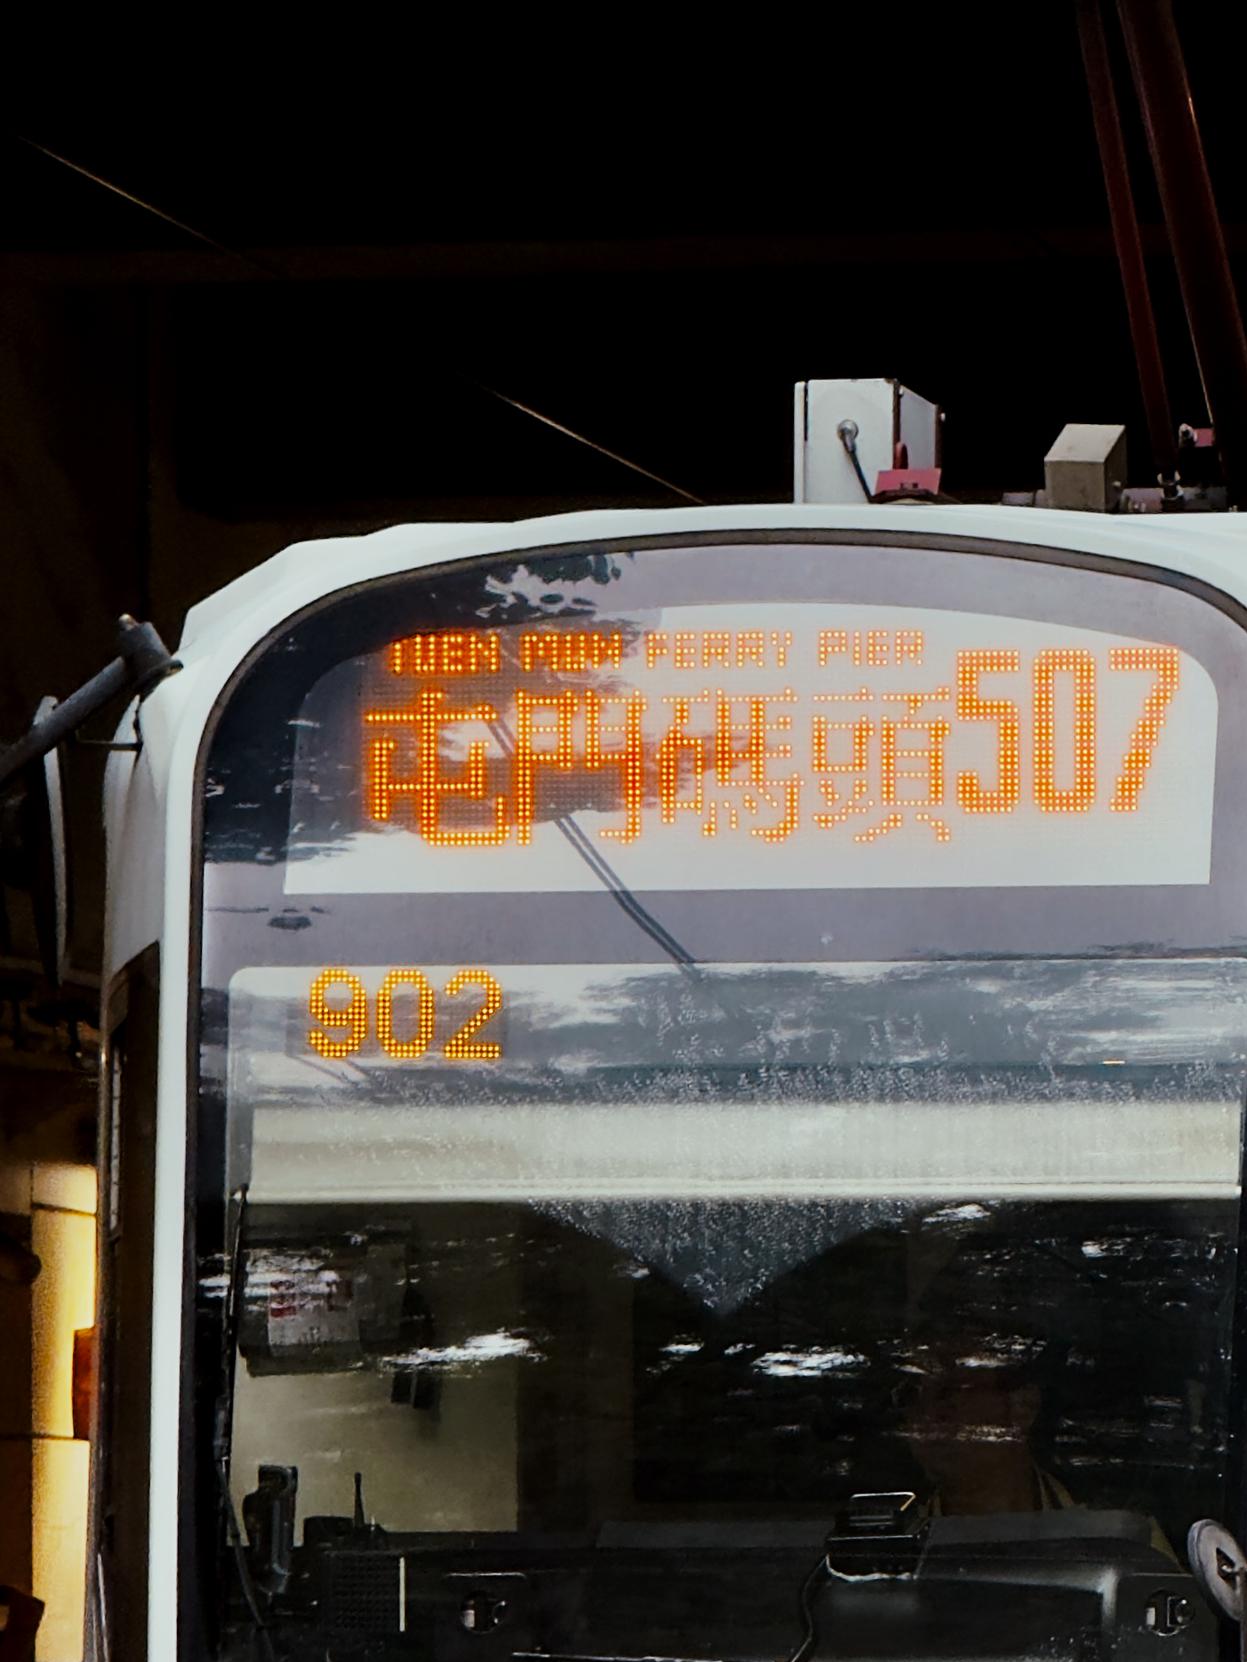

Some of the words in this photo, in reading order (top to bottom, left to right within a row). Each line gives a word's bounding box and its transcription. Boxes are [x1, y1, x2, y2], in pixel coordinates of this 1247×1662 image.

[520, 631, 622, 672] MUN
[645, 630, 793, 669] FERRY
[819, 629, 924, 667] PIER
[365, 688, 951, 845] 屯門碼頭
[956, 647, 1180, 813] 507
[309, 969, 501, 1058] 902
